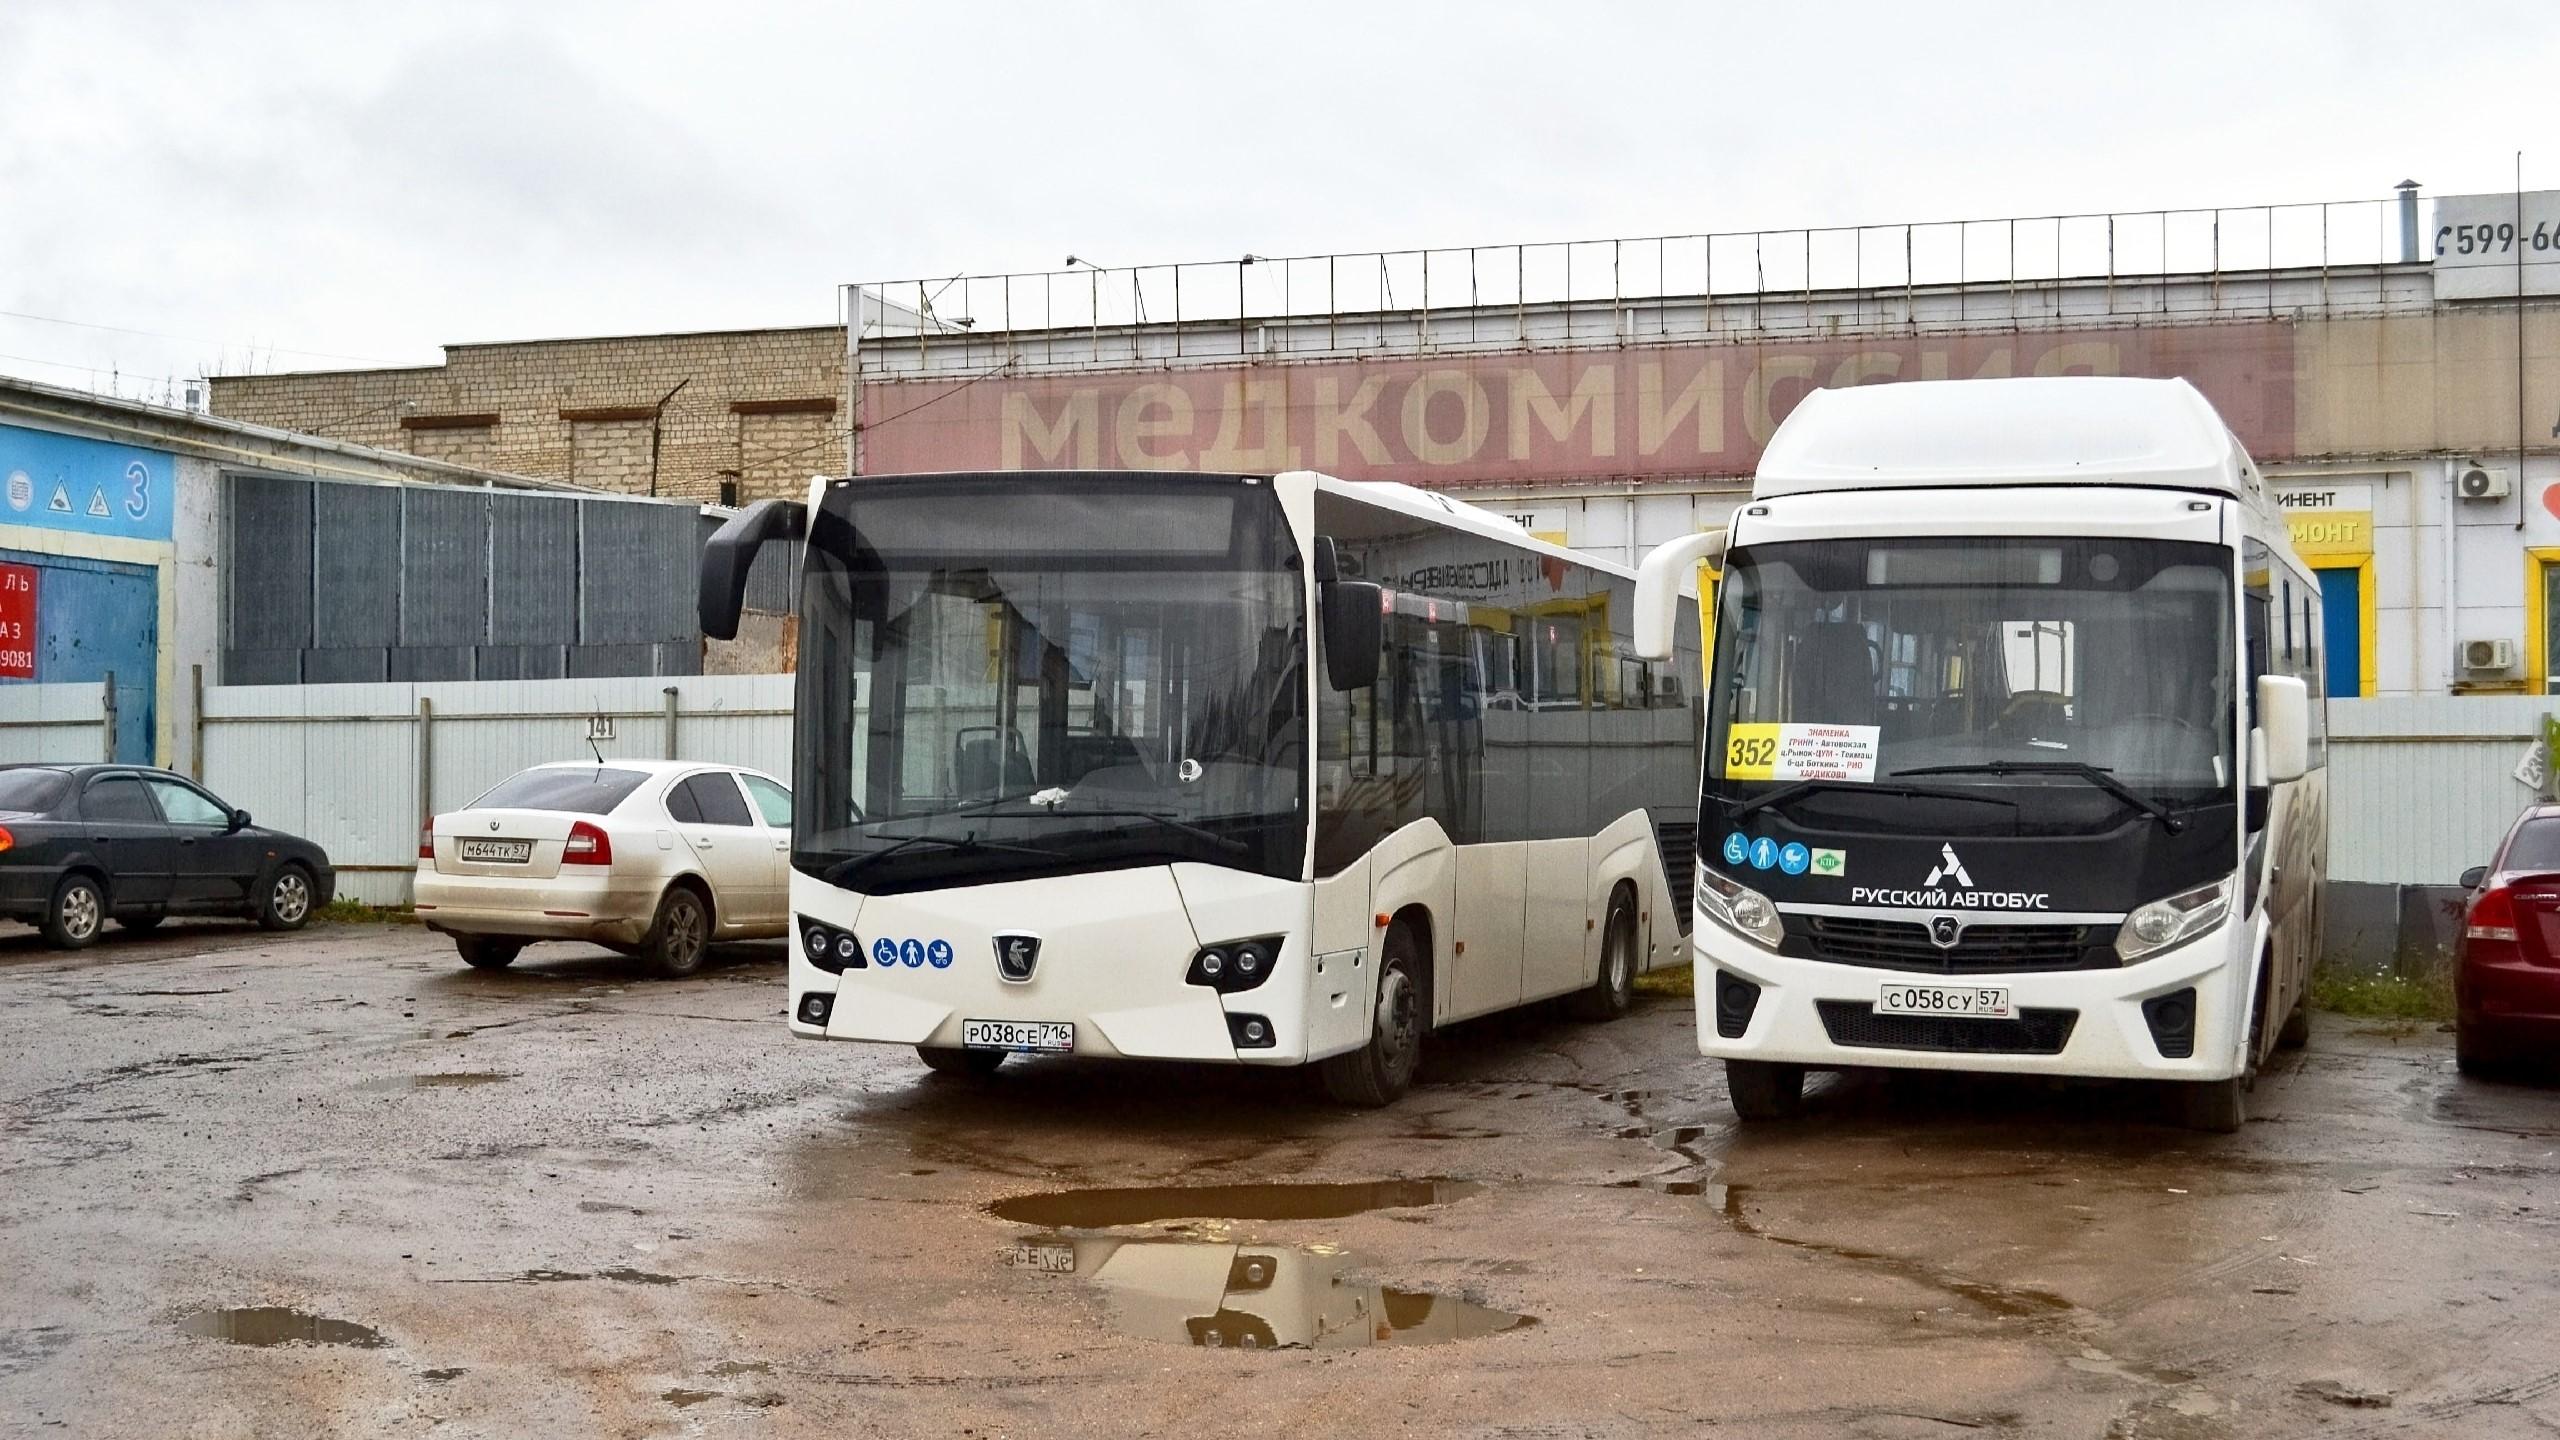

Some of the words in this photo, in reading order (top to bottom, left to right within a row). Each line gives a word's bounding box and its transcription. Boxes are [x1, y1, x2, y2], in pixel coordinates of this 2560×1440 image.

[126, 460, 150, 521] 3
[2274, 491, 2336, 507] ИНЕНТ
[0, 650, 33, 669] 9081
[587, 716, 614, 737] 141
[1808, 728, 1849, 738] ЗНАМЕНКА
[1730, 738, 1776, 767] 352
[1821, 740, 1867, 749] Автовокзал
[1806, 759, 1839, 768] Боткина
[1846, 761, 1863, 769] РИО
[1851, 886, 1947, 907] РУССКИЙ
[1950, 891, 2049, 909] АВТОБУС
